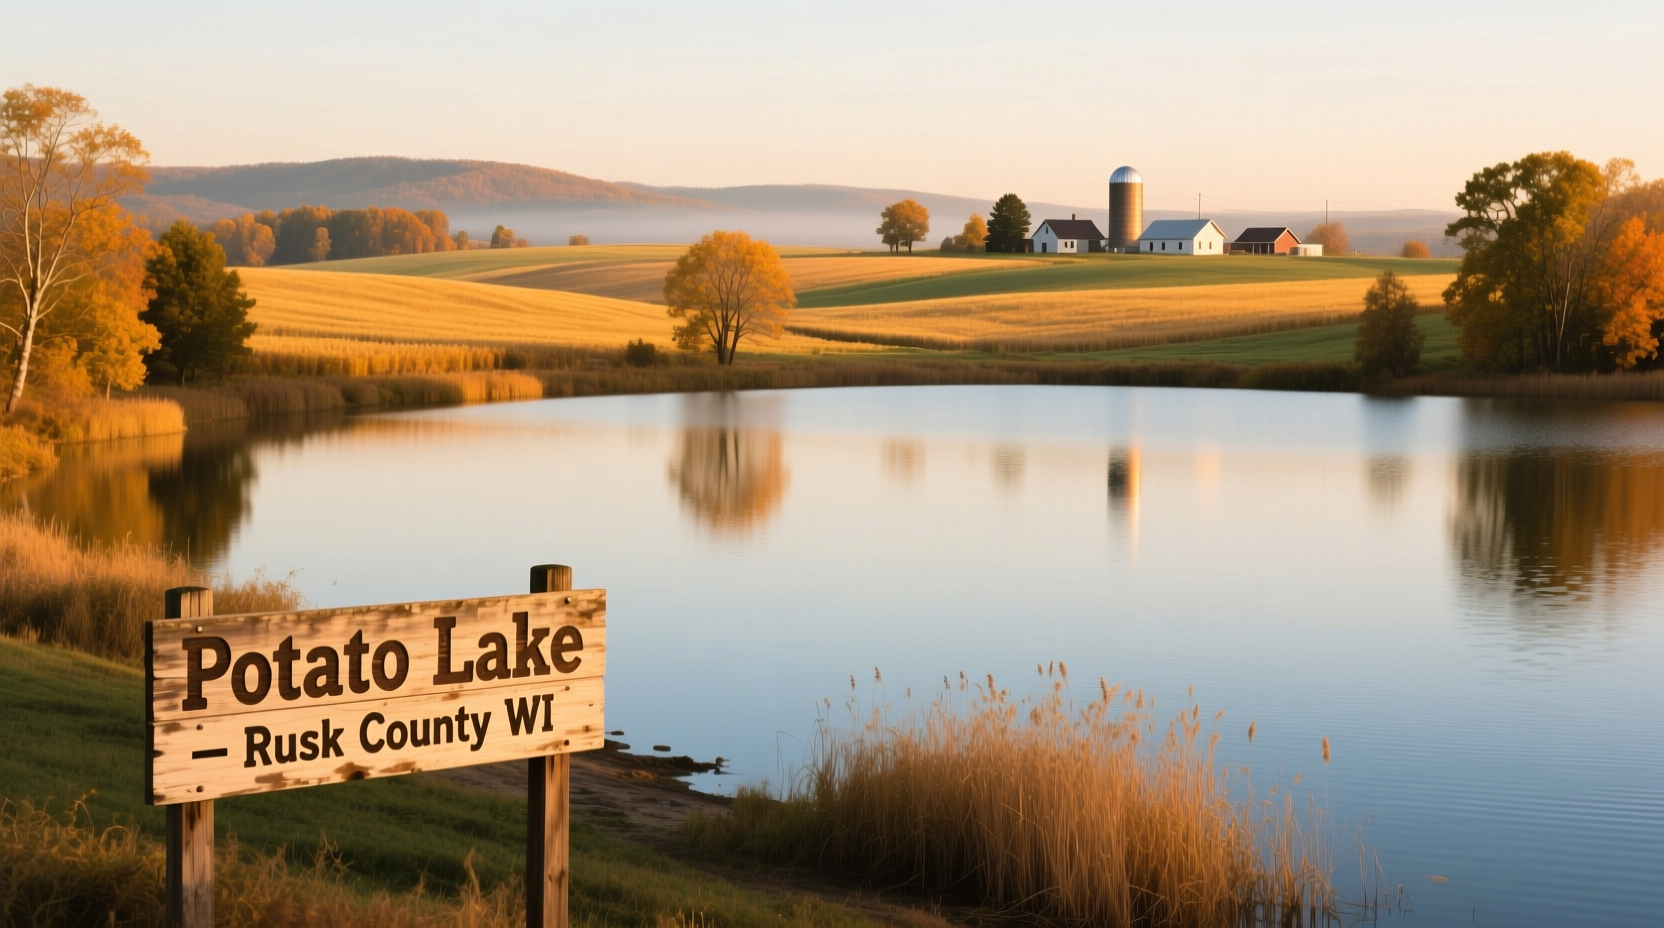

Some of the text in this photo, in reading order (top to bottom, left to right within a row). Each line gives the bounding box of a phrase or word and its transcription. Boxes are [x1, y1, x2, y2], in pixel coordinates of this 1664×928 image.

[181, 611, 584, 711] Potato Lake
[244, 718, 345, 768] Rusk
[359, 705, 492, 752] County
[504, 693, 554, 736] WI
